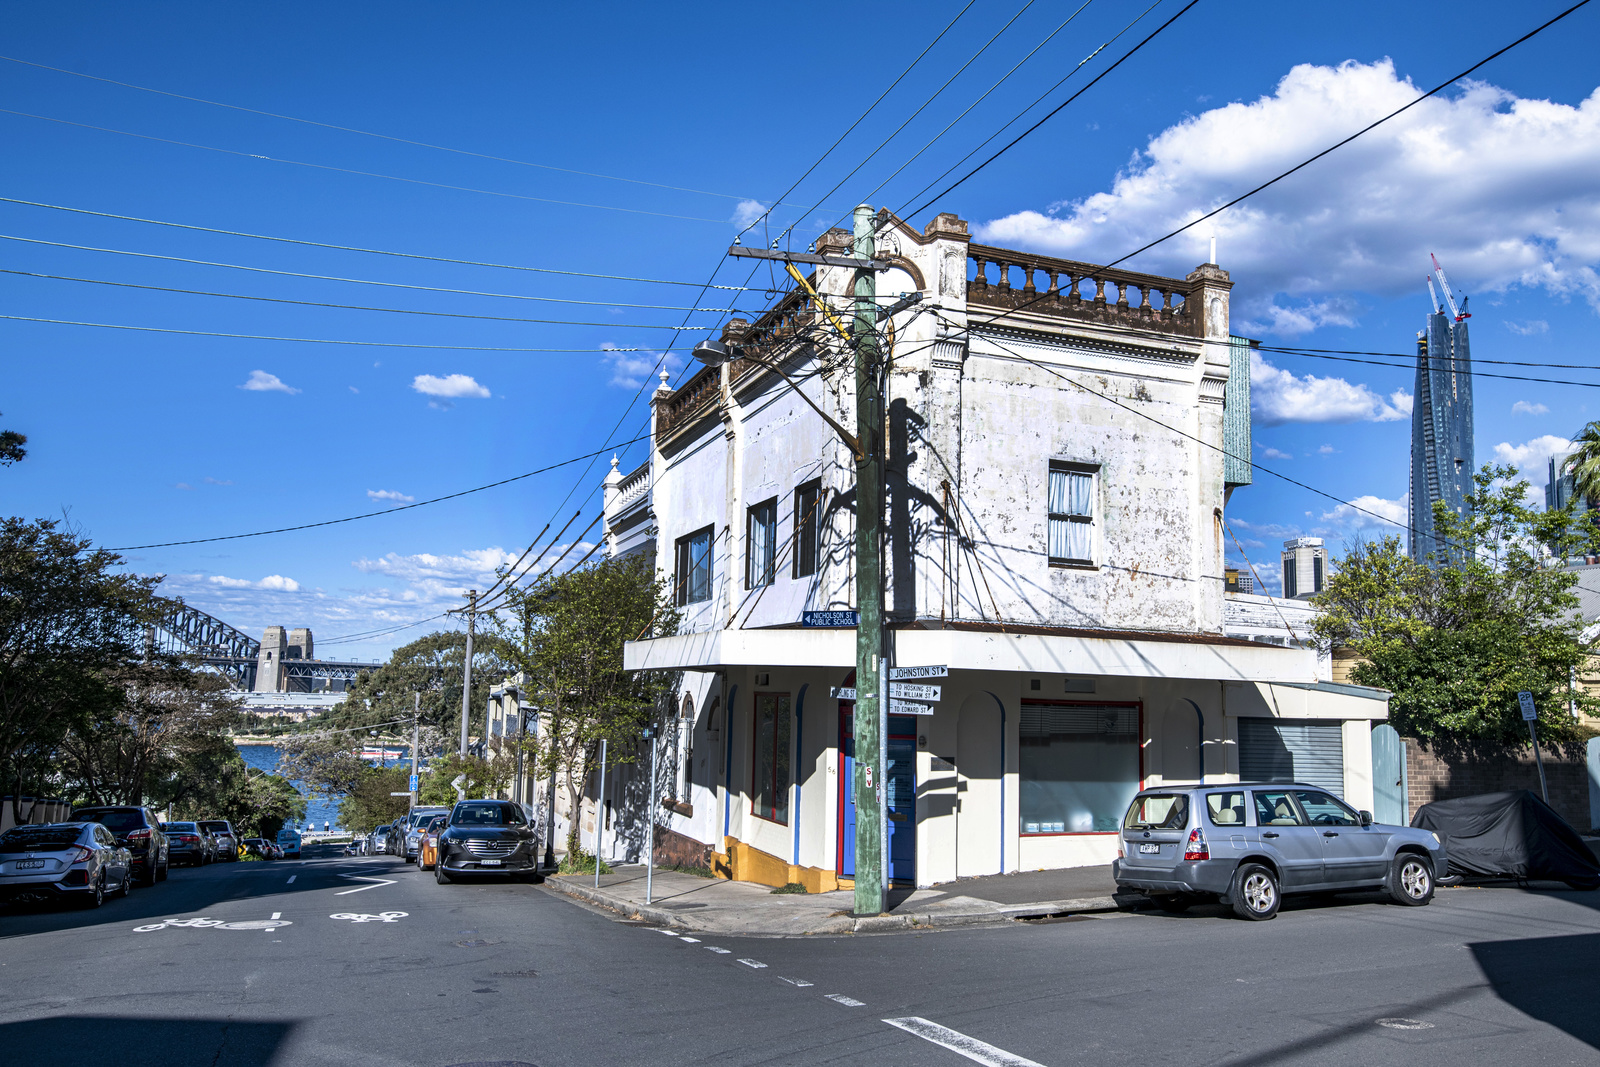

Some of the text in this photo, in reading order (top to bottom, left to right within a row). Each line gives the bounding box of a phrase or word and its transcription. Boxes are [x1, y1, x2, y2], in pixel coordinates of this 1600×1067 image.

[895, 666, 940, 678] JOHNSTON ST
[1520, 694, 1530, 702] 2P
